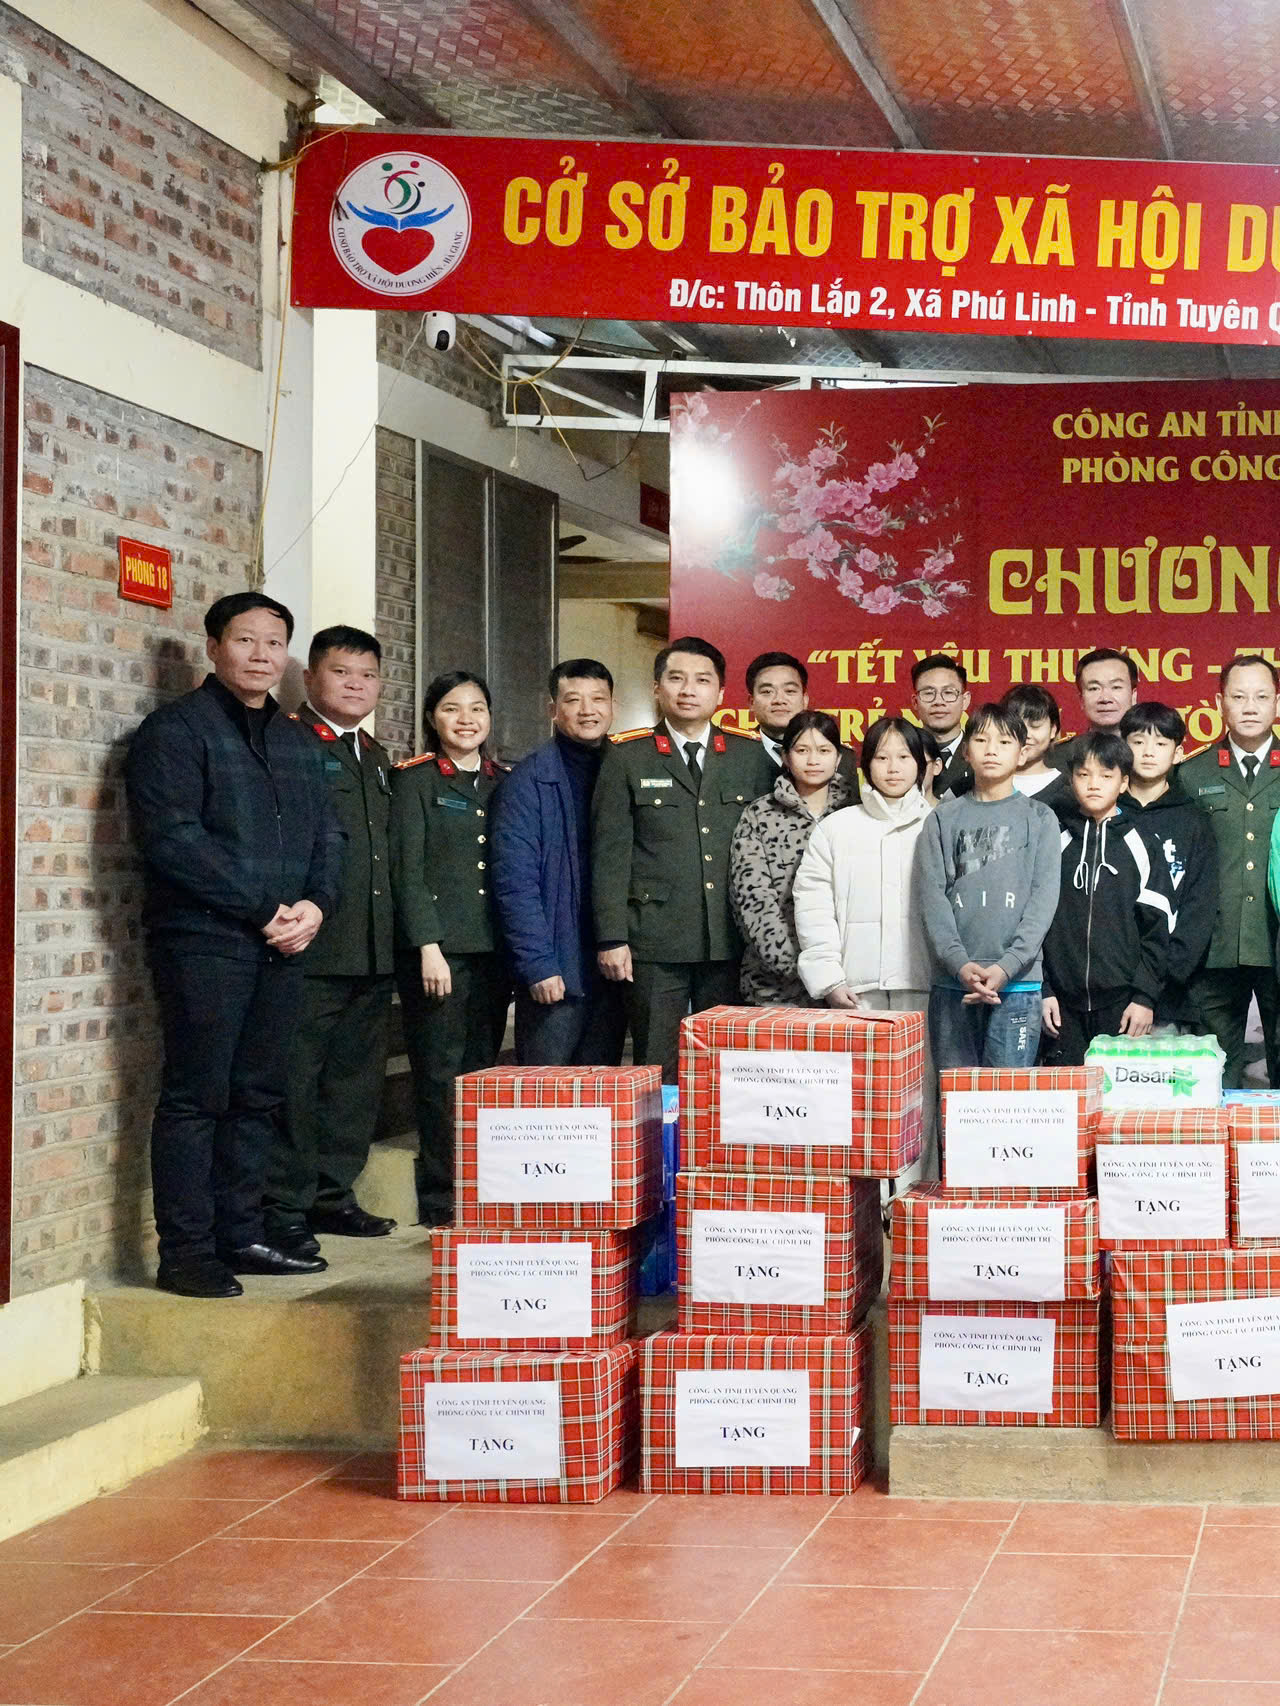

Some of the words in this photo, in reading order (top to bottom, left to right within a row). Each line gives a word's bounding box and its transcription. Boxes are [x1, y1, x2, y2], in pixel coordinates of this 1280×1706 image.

[504, 157, 587, 246] CỞ
[606, 159, 690, 251] SỞ
[710, 163, 832, 256] BẢO
[856, 188, 974, 277] TRỢ
[991, 184, 1074, 265] XÃ
[1098, 186, 1201, 284] HỘI
[670, 279, 724, 308] Đ/c:
[735, 282, 800, 312] Thôn
[812, 279, 860, 317] Lắp
[870, 287, 894, 319] 2,
[906, 288, 941, 317] Xã
[952, 290, 1005, 320] Phú
[1016, 293, 1076, 322] Linh
[1107, 293, 1166, 326] Tỉnh
[1177, 299, 1258, 332] Tuyên
[1053, 408, 1148, 439] CÔNG
[1158, 411, 1206, 437] AN
[1063, 452, 1179, 483] PHÒNG
[125, 552, 155, 587] PHÒNG
[157, 565, 168, 591] 18
[762, 1105, 807, 1120] TẶNG
[988, 1146, 1033, 1161] TẶNG
[520, 1162, 565, 1177] TẶNG
[1134, 1199, 1179, 1215] TẶNG
[734, 1265, 779, 1279] TẶNG
[973, 1264, 1018, 1279] TẶNG
[501, 1298, 546, 1313] TẶNG
[1216, 1355, 1261, 1372] TẶNG
[963, 1371, 1008, 1387] TẶNG
[719, 1426, 764, 1441] TẶNG
[468, 1438, 513, 1453] TẶNG
